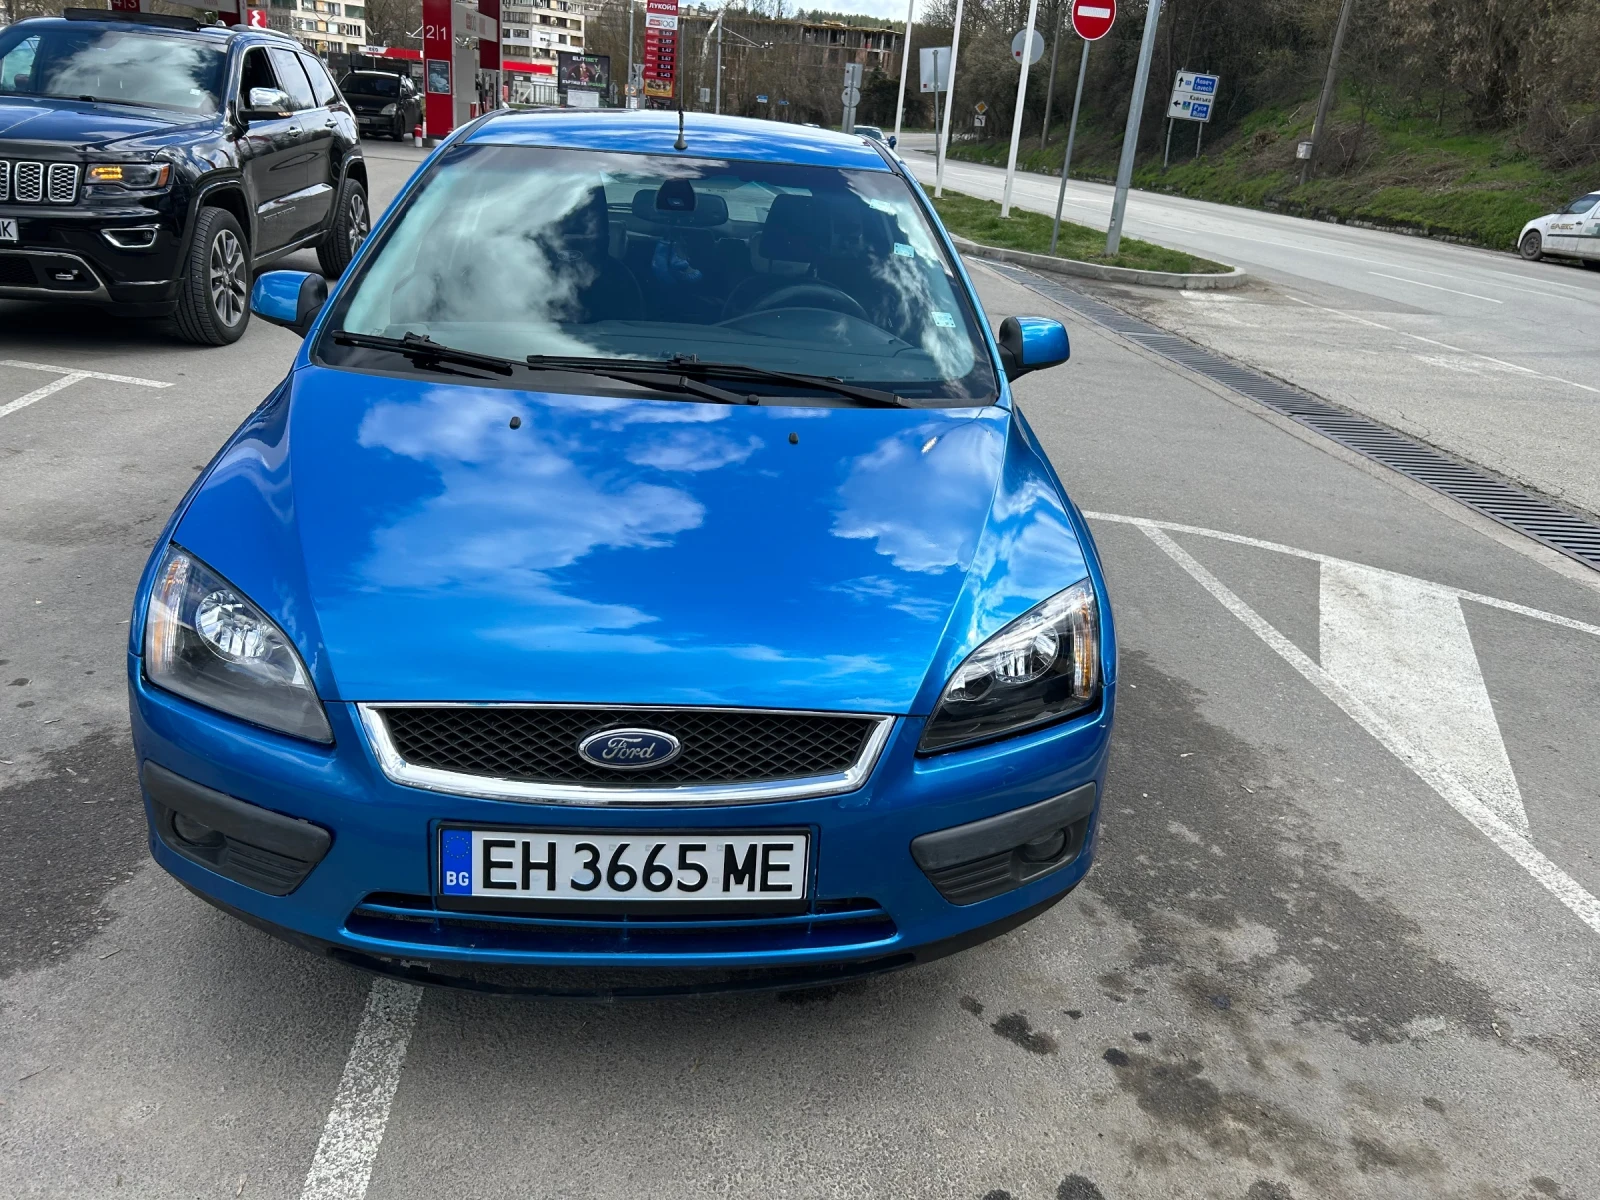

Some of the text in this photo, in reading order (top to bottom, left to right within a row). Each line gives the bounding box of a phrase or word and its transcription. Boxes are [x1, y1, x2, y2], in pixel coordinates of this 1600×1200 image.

[1193, 104, 1207, 112] Русе
[0, 220, 13, 238] K
[602, 737, 656, 759] Ford
[482, 839, 795, 893] EH 3665 ME
[446, 871, 469, 886] BG
